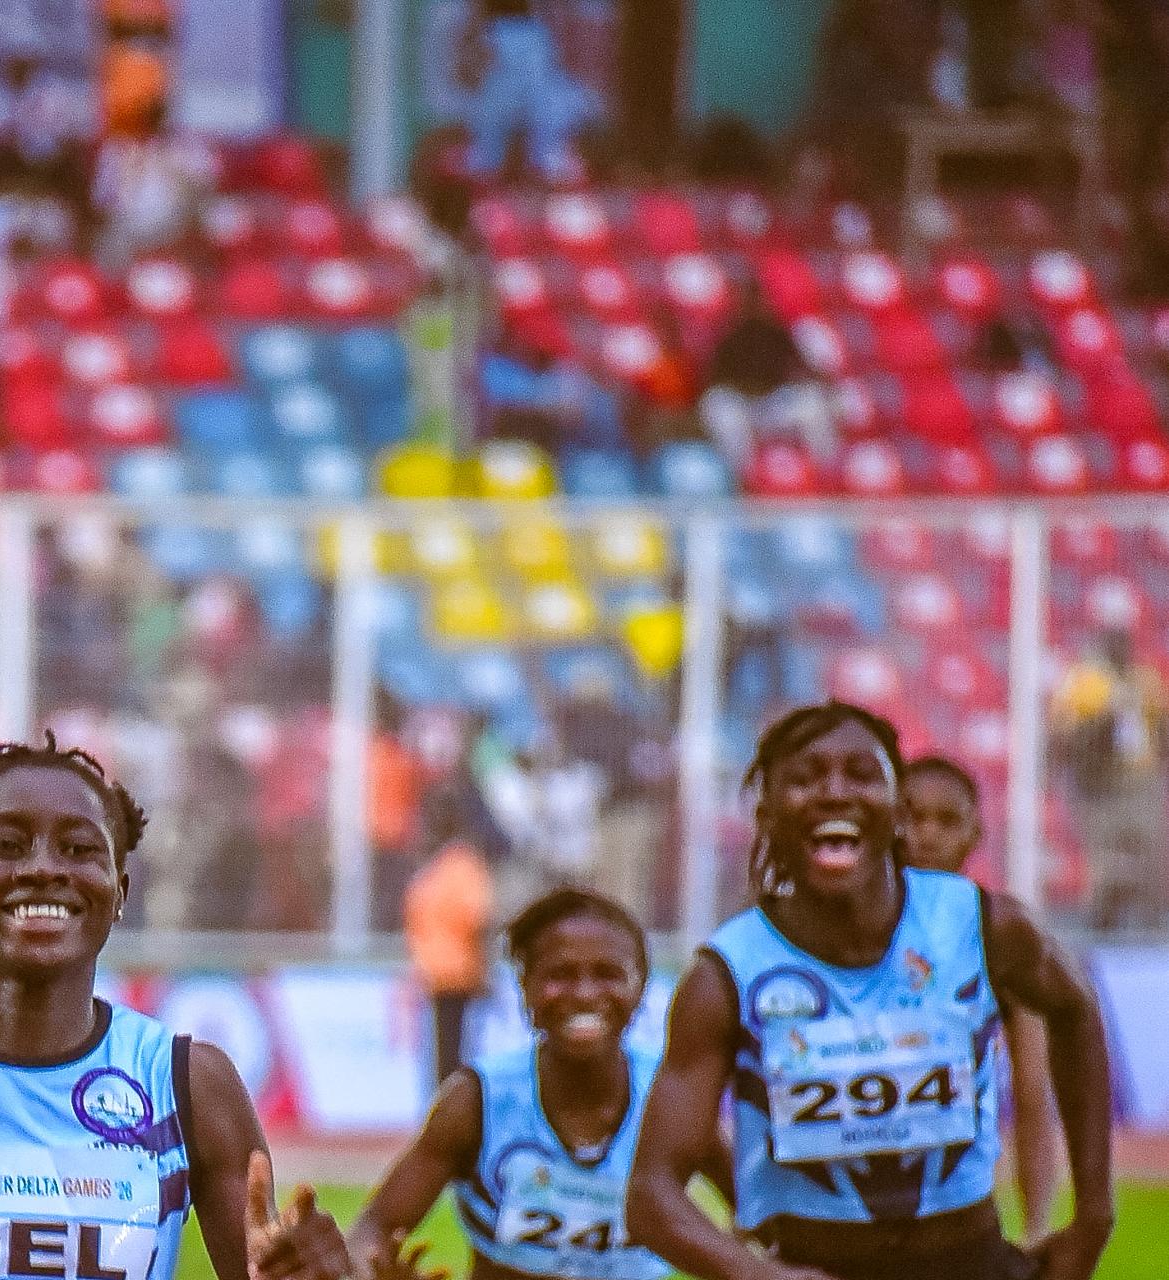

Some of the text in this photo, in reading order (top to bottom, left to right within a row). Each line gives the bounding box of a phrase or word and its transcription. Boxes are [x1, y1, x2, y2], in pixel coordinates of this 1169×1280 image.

[790, 1065, 959, 1126] 294
[16, 1175, 61, 1197] DELTA
[62, 1177, 112, 1200] GAMES
[517, 1208, 614, 1254] 24
